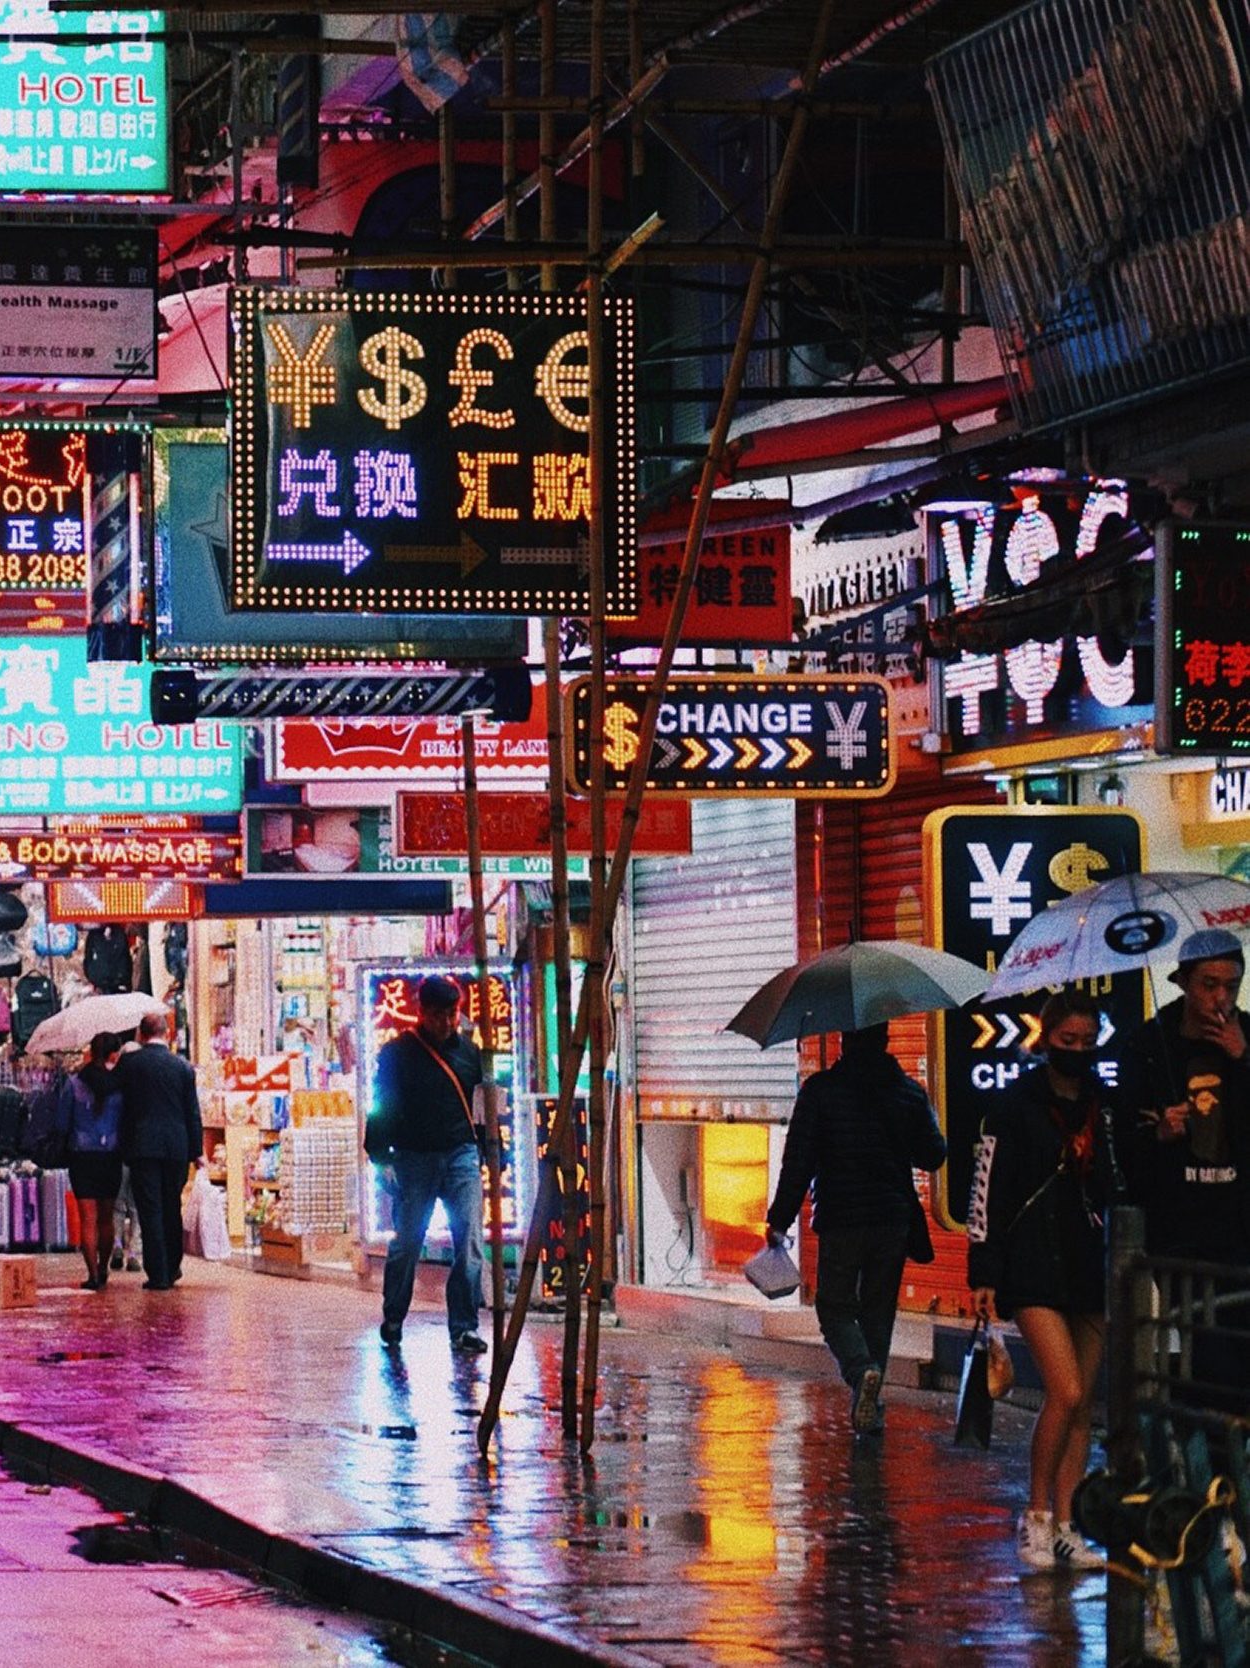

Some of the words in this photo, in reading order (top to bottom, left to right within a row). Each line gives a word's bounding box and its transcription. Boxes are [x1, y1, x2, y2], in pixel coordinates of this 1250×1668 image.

[17, 73, 156, 105] HOTEL
[47, 295, 120, 311] Massage
[267, 323, 337, 430] ¥
[356, 325, 429, 431] $
[448, 327, 516, 430] £
[534, 329, 592, 434] €
[655, 702, 812, 734] CHANGE
[101, 721, 233, 750] HOTEL
[420, 740, 499, 757] BEATY
[17, 839, 89, 864] BODY
[90, 840, 213, 865] MASSAGE
[378, 857, 445, 872] HOTEL
[458, 858, 510, 872] FEE
[966, 842, 1034, 936] ¥
[971, 1061, 1119, 1090] CHE
